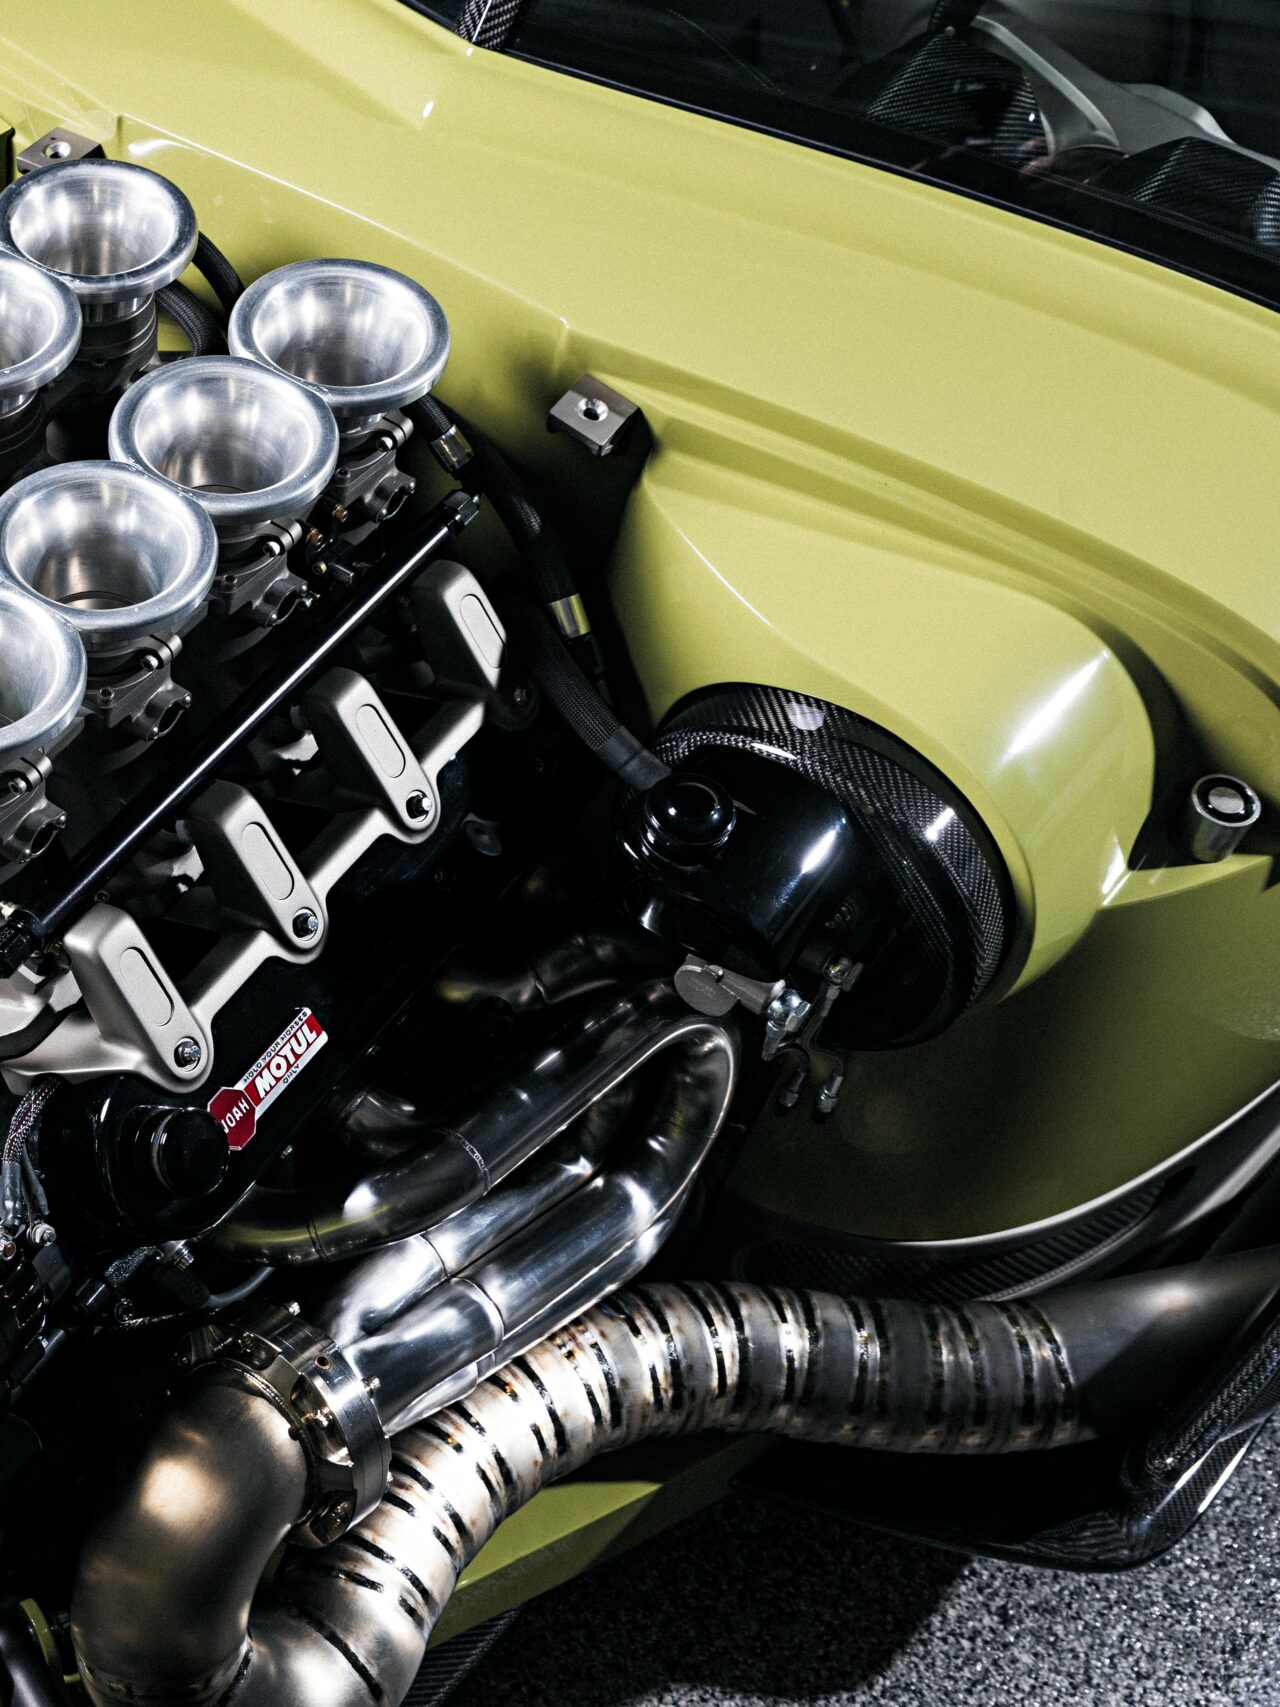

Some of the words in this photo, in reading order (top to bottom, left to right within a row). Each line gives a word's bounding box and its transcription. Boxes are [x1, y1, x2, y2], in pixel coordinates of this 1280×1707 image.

[243, 1061, 263, 1083] HOLD
[262, 1041, 281, 1062] YOUR
[280, 1010, 308, 1042] HORSES
[254, 1022, 318, 1100] MOTUL
[282, 1063, 301, 1085] ONLY
